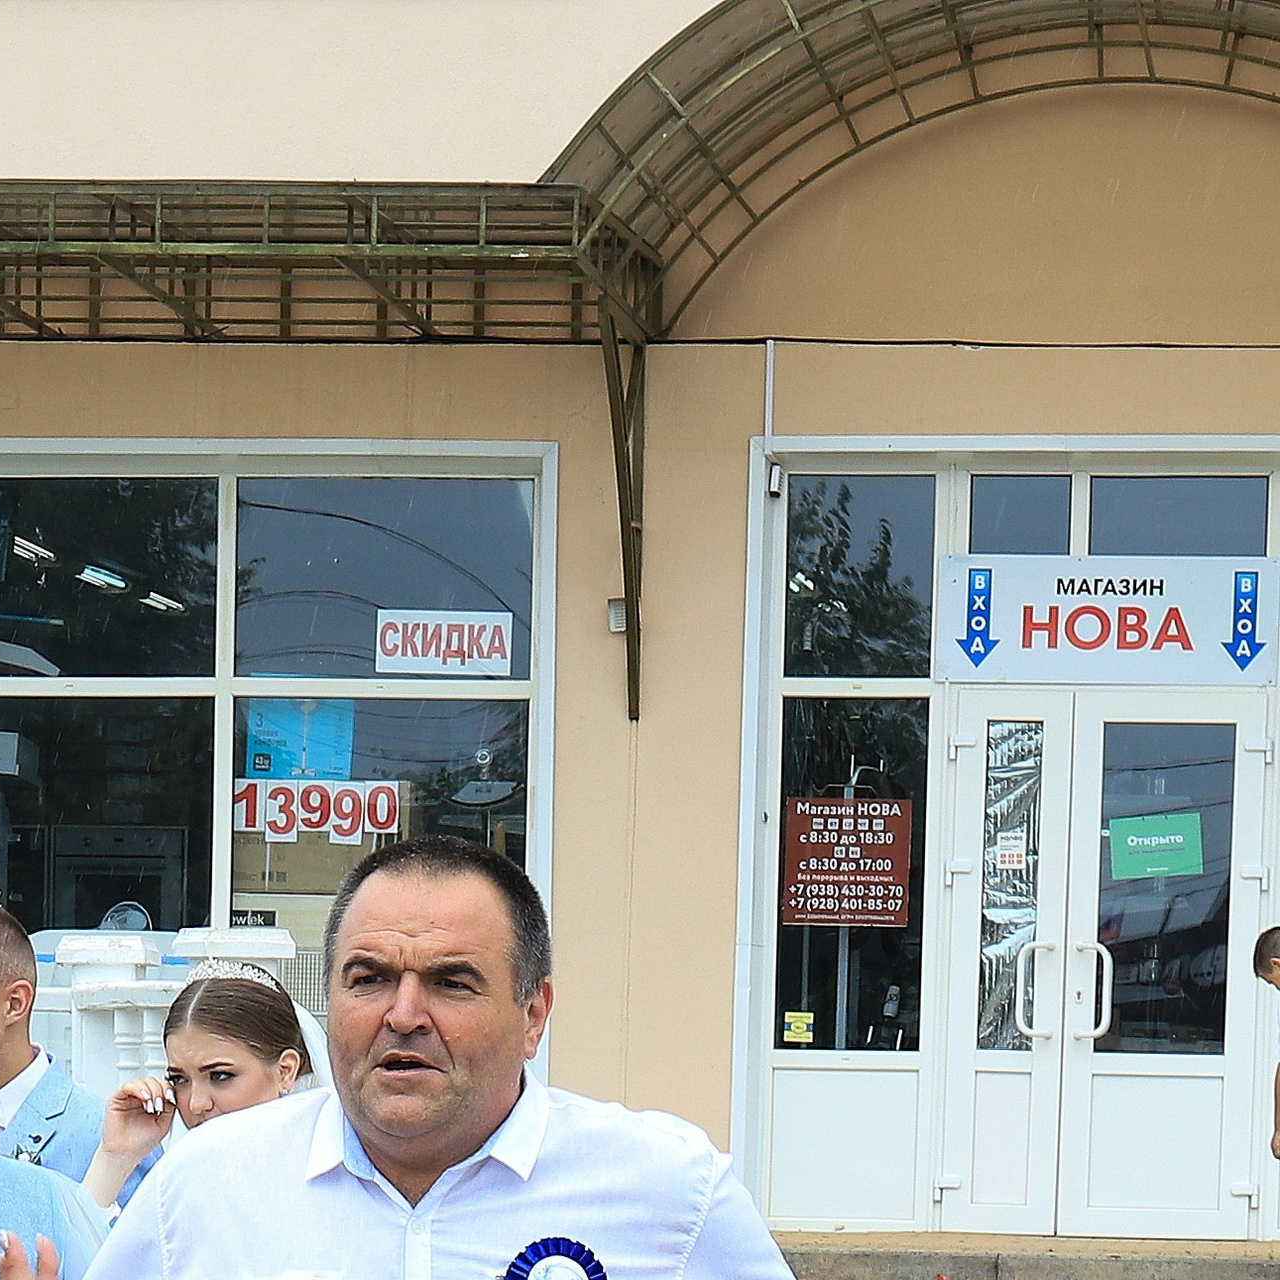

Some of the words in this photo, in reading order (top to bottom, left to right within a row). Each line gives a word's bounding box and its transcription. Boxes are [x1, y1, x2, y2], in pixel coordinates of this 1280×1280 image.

[1056, 578, 1164, 596] МАГАЗИН
[970, 574, 986, 655] ВХОД
[1236, 577, 1252, 658] ВХОД
[1021, 604, 1195, 651] НОВА
[379, 621, 508, 666] СКИДКА
[234, 783, 397, 837] 13990
[796, 802, 854, 815] Магазин
[857, 803, 902, 816] НОВА
[799, 834, 807, 842] с
[809, 831, 838, 843] 8:30
[840, 834, 857, 845] до
[859, 832, 894, 844] 18:30
[1127, 834, 1184, 847] Открыто
[799, 861, 807, 869] с
[809, 858, 838, 870] 8:30
[839, 862, 856, 871] до
[858, 859, 892, 871] 17:00
[789, 884, 805, 895] +7
[806, 884, 839, 898] (938)
[841, 885, 903, 897] 430-30-70
[789, 898, 805, 909] +7
[806, 898, 839, 911] (928)
[841, 899, 903, 911] 401-85-07
